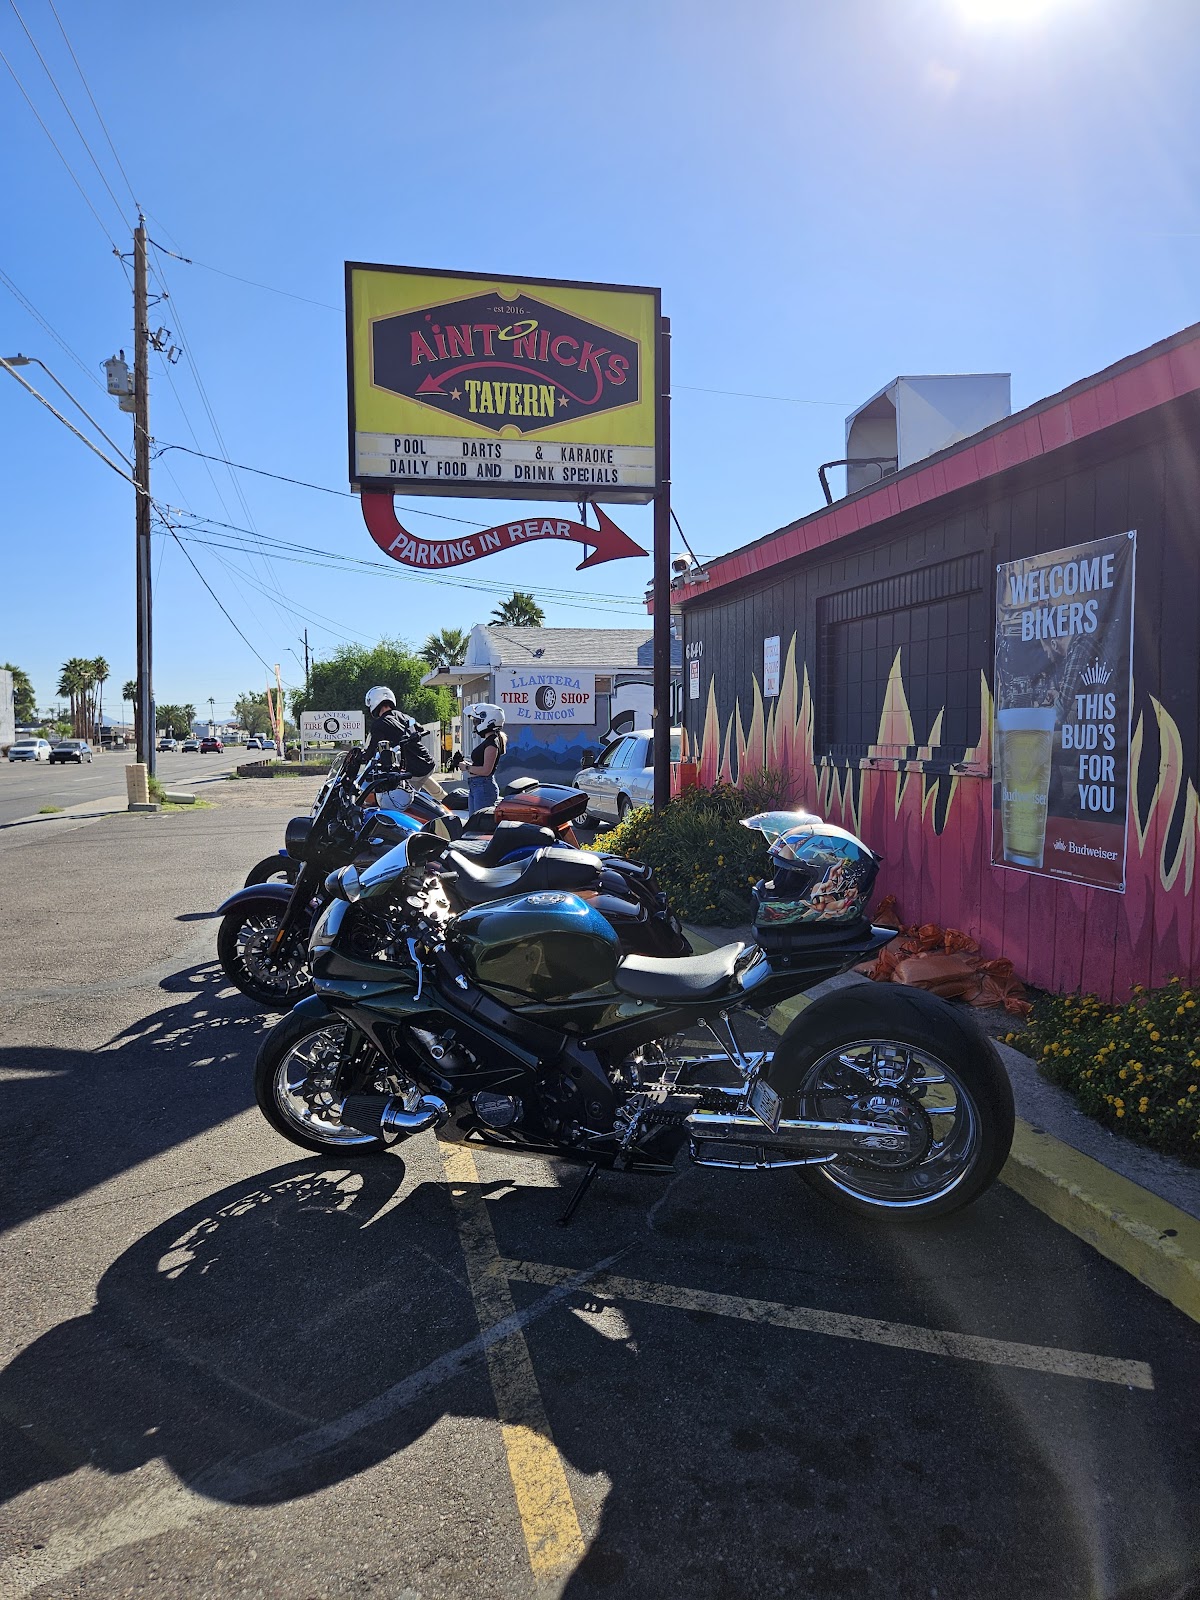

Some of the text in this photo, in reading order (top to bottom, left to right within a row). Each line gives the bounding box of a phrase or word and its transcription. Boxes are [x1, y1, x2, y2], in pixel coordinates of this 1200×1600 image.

[493, 305, 525, 315] est 2016
[512, 324, 630, 386] NICKS
[464, 379, 556, 417] TAVERN
[394, 438, 613, 464] POOL DARTS & KARAOKE
[390, 459, 619, 484] DAILY FOOD AND DRINK SPECIALS
[388, 520, 571, 565] PARKING IN REAR
[1010, 553, 1115, 606] WELCOME
[1021, 599, 1099, 642] BIKERS
[510, 675, 581, 690] LLANTERA
[500, 692, 590, 704] TIRE SHOP
[1074, 692, 1116, 720] THIS
[304, 721, 361, 730] TIRE SHOP
[313, 712, 350, 721] LLANTERA
[517, 707, 576, 720] EL RINCON
[313, 731, 323, 739] EL
[324, 730, 353, 740] RINCON
[1061, 723, 1116, 751] BUD'S
[1078, 754, 1115, 782] FOR
[1002, 786, 1047, 805] Budiser
[1077, 784, 1115, 813] YOU
[1068, 841, 1118, 861] Budweiser
